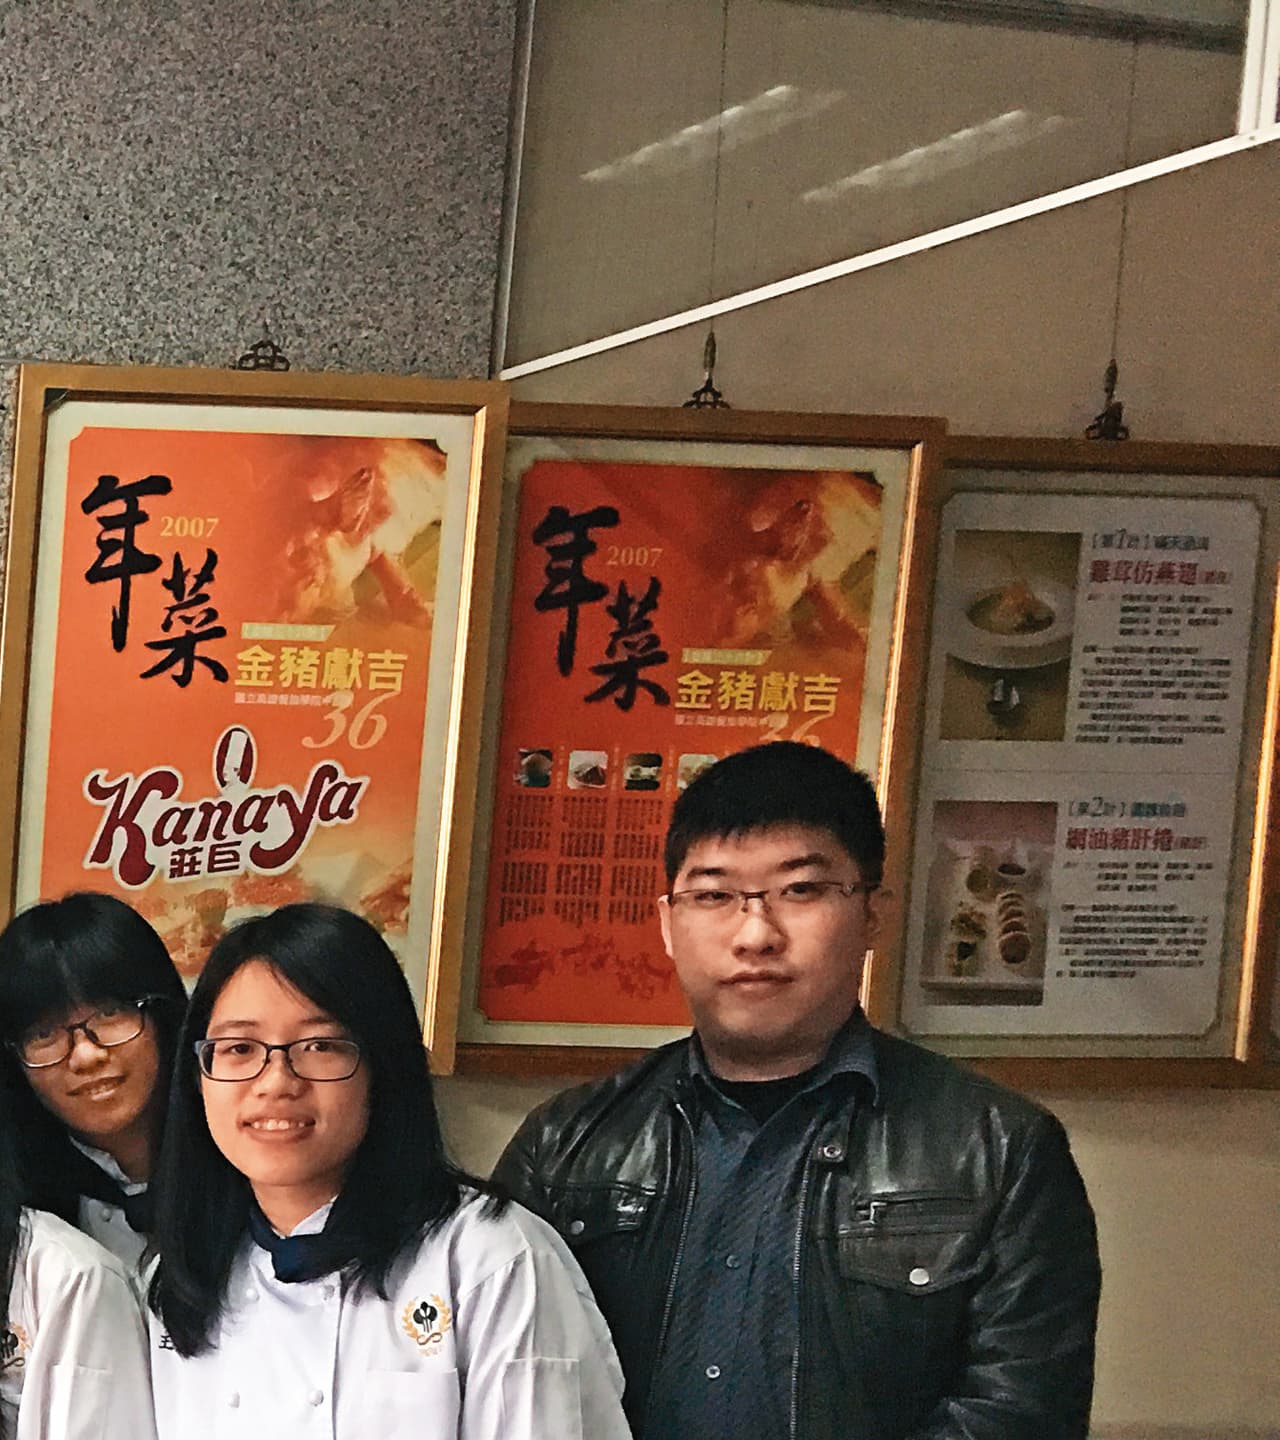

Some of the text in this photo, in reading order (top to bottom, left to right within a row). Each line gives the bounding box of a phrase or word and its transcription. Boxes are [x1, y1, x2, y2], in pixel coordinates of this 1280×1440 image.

[160, 516, 219, 537] 2007
[607, 546, 663, 567] 2007
[81, 475, 228, 688] 年菜
[234, 644, 409, 691] 金豬獻吉
[675, 669, 842, 713] 金豬獻吉
[87, 763, 363, 886] Kanaya
